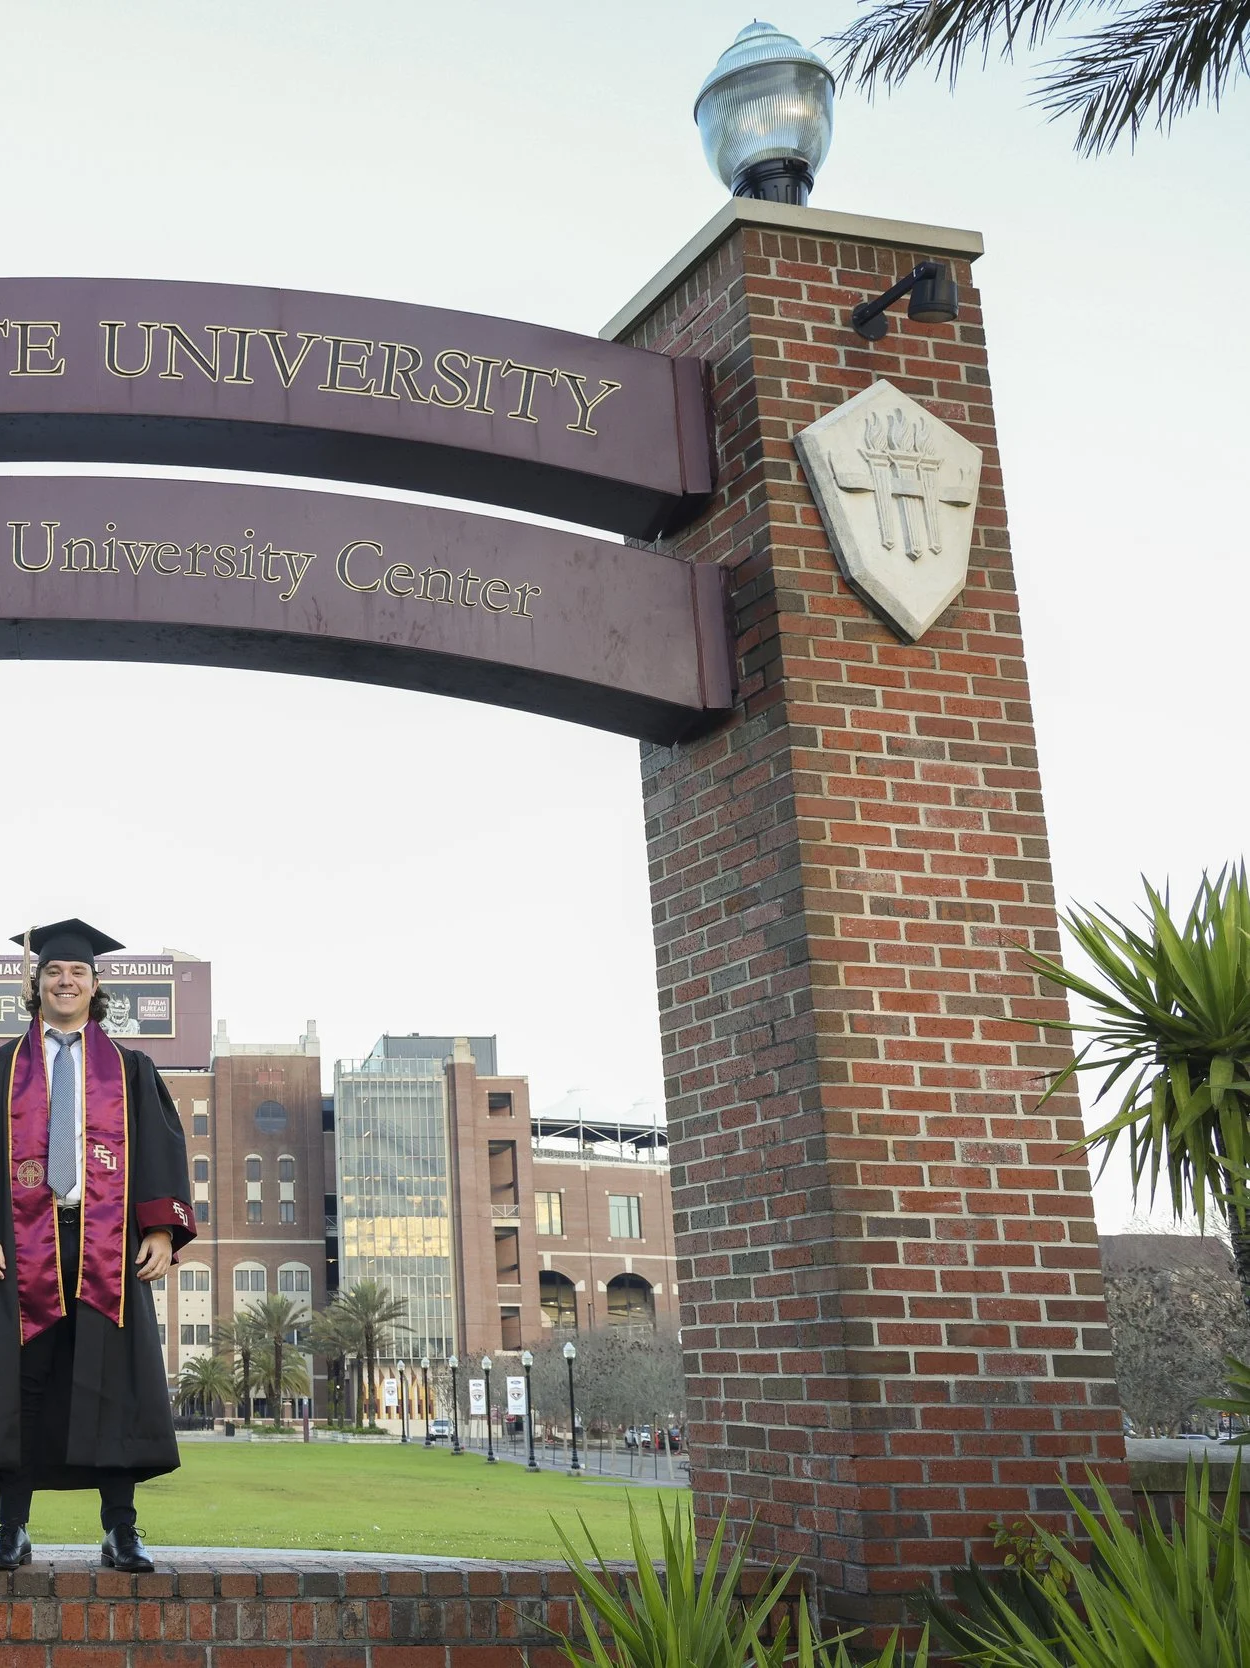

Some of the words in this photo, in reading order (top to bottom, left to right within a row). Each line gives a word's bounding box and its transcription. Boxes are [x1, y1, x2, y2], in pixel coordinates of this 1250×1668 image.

[99, 320, 621, 436] UNIVERSITY
[6, 521, 317, 602] University
[334, 539, 543, 619] Center
[111, 963, 174, 975] STADIUM
[93, 1144, 117, 1170] FSU
[173, 1201, 188, 1227] FSU
